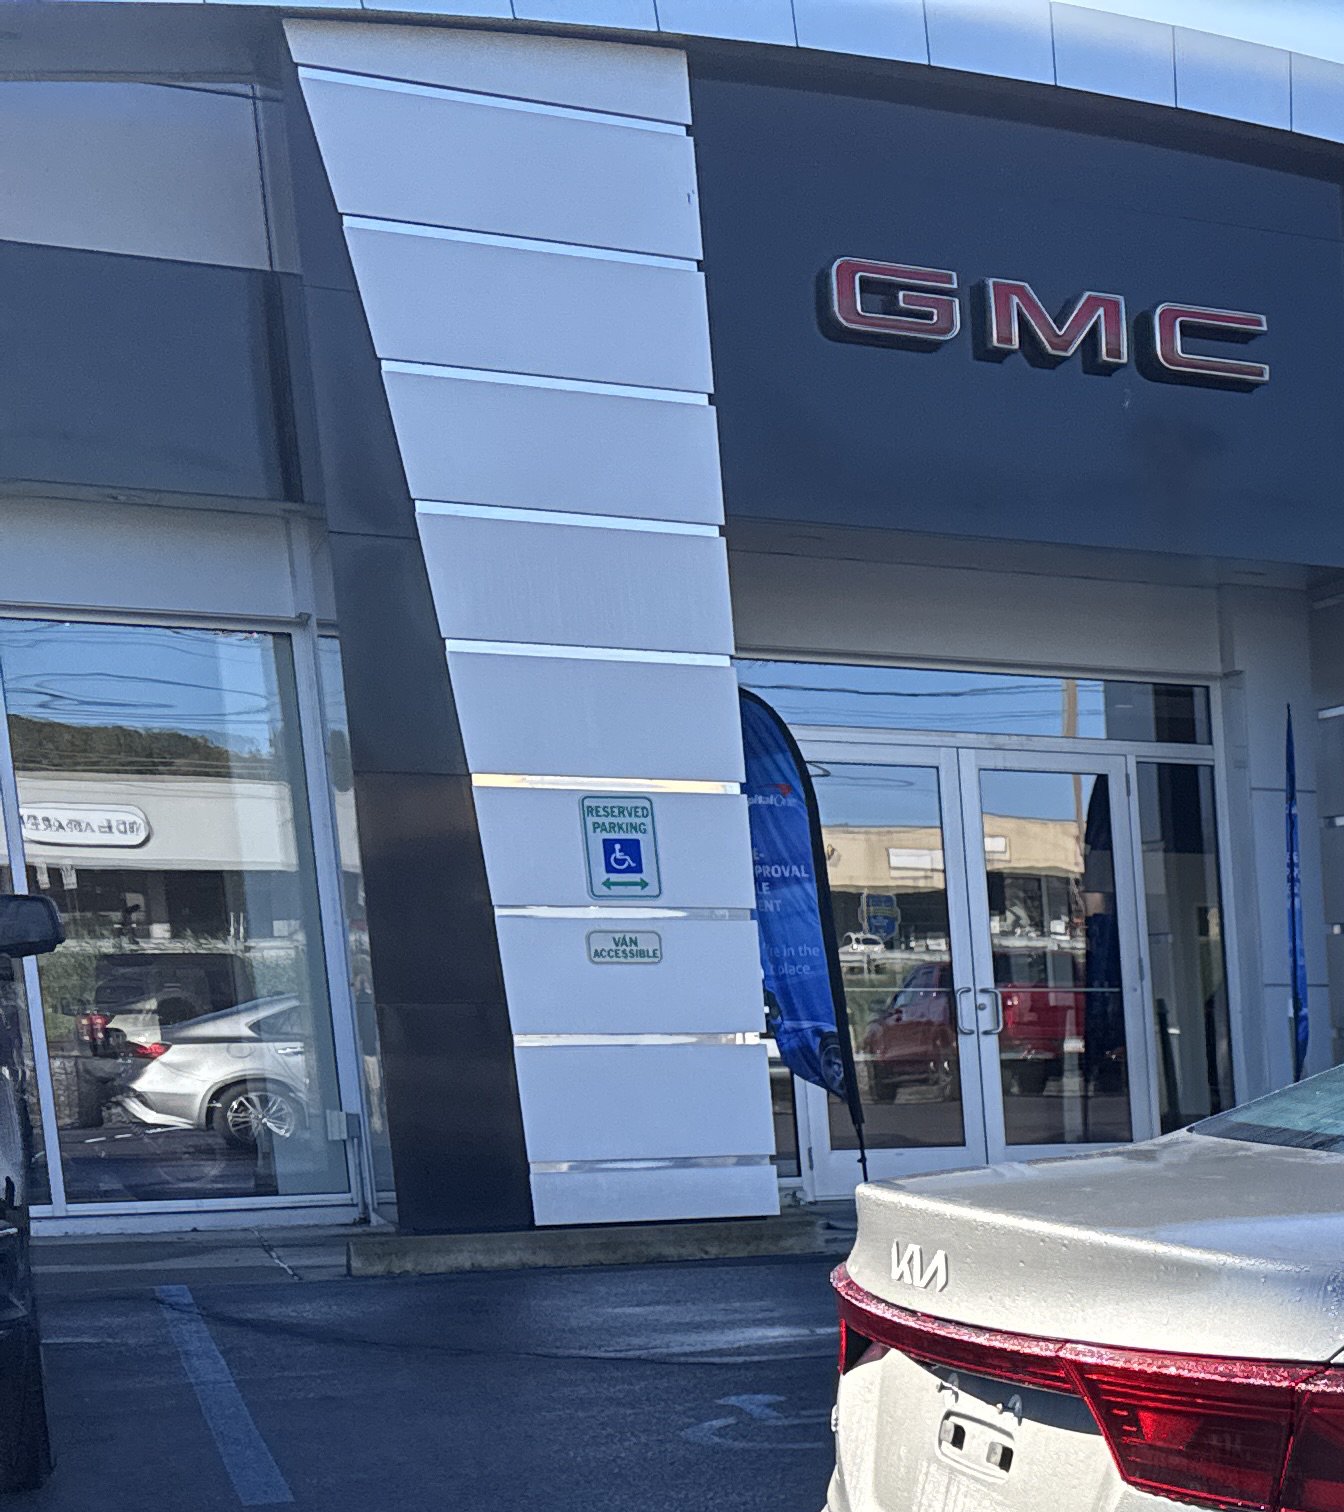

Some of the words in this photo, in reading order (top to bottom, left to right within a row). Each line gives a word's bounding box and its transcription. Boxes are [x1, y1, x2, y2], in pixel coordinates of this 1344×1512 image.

[830, 256, 1270, 382] GMC
[585, 805, 650, 819] RESERVED
[592, 821, 648, 834] PARKING
[612, 935, 639, 948] VAN
[593, 948, 660, 960] ACCESSIBLE
[798, 943, 820, 957] the
